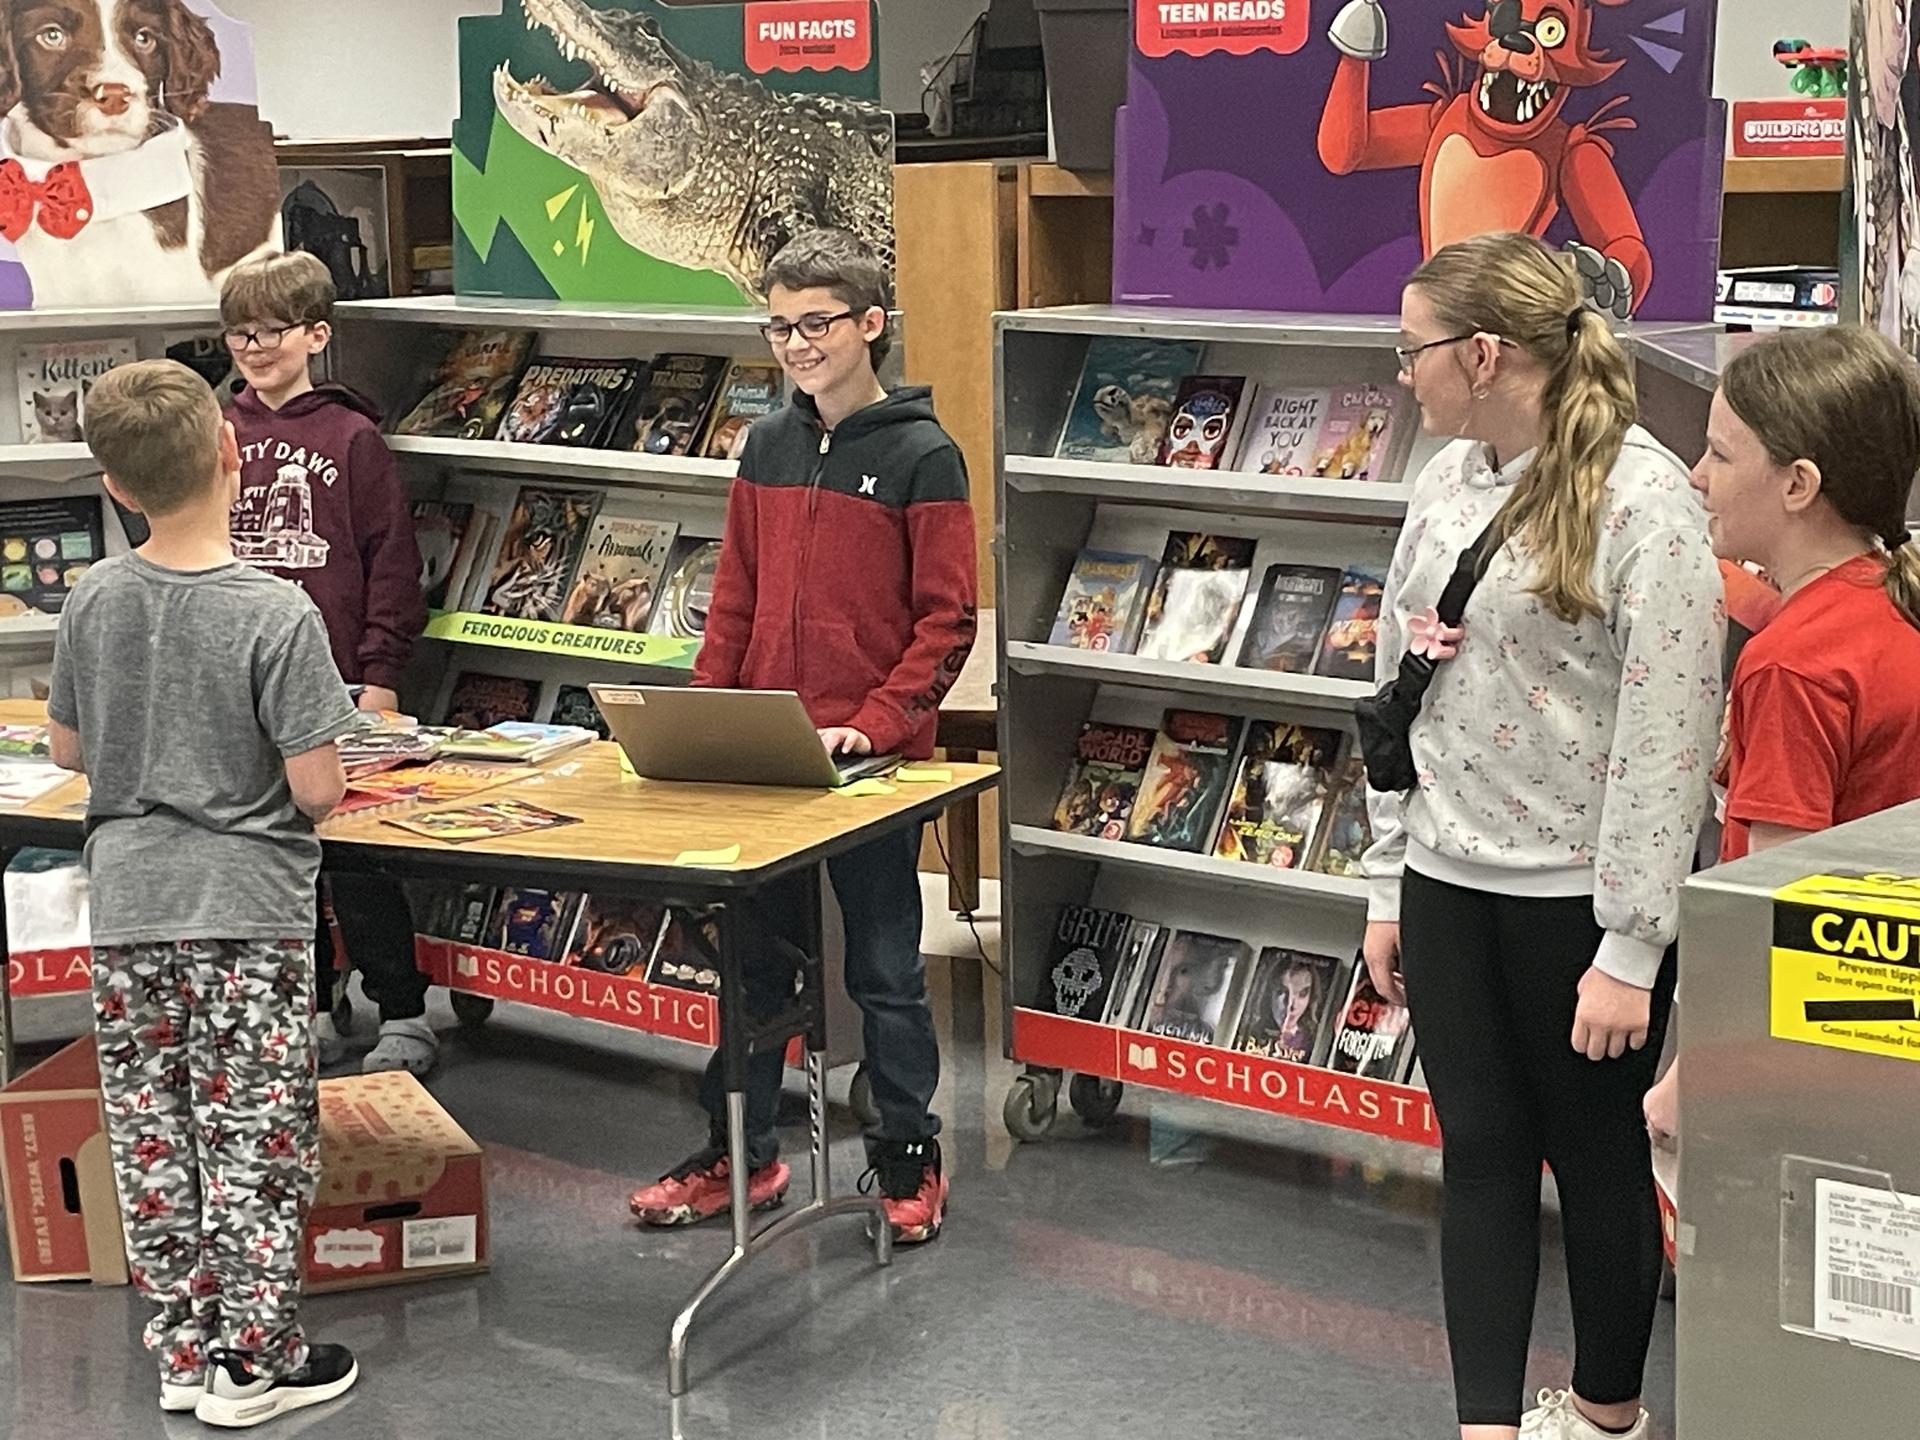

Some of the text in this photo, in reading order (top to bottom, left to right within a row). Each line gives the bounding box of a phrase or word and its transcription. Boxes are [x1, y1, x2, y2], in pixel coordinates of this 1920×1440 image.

[1158, 0, 1286, 24] TEEN READS
[759, 19, 856, 41] FUN FACTS
[1745, 121, 1821, 141] BUILDING
[520, 365, 628, 389] PREDATORS
[727, 384, 769, 399] Animal
[729, 400, 771, 415] Homes
[1272, 398, 1318, 414] RIGHT
[1264, 416, 1297, 429] BACK
[1298, 416, 1317, 429] AT
[1270, 431, 1304, 448] YOU
[241, 437, 339, 487] TY DAWG
[462, 620, 647, 655] FEROCIOUS CREATURES
[1078, 746, 1142, 764] WORLD
[1838, 960, 1888, 978] Prevent
[486, 958, 705, 1029] SCHOLASTIC
[1816, 971, 1915, 996] Do not open cases
[1854, 1028, 1904, 1046] intended
[1167, 1050, 1432, 1131] SCHOLASTI
